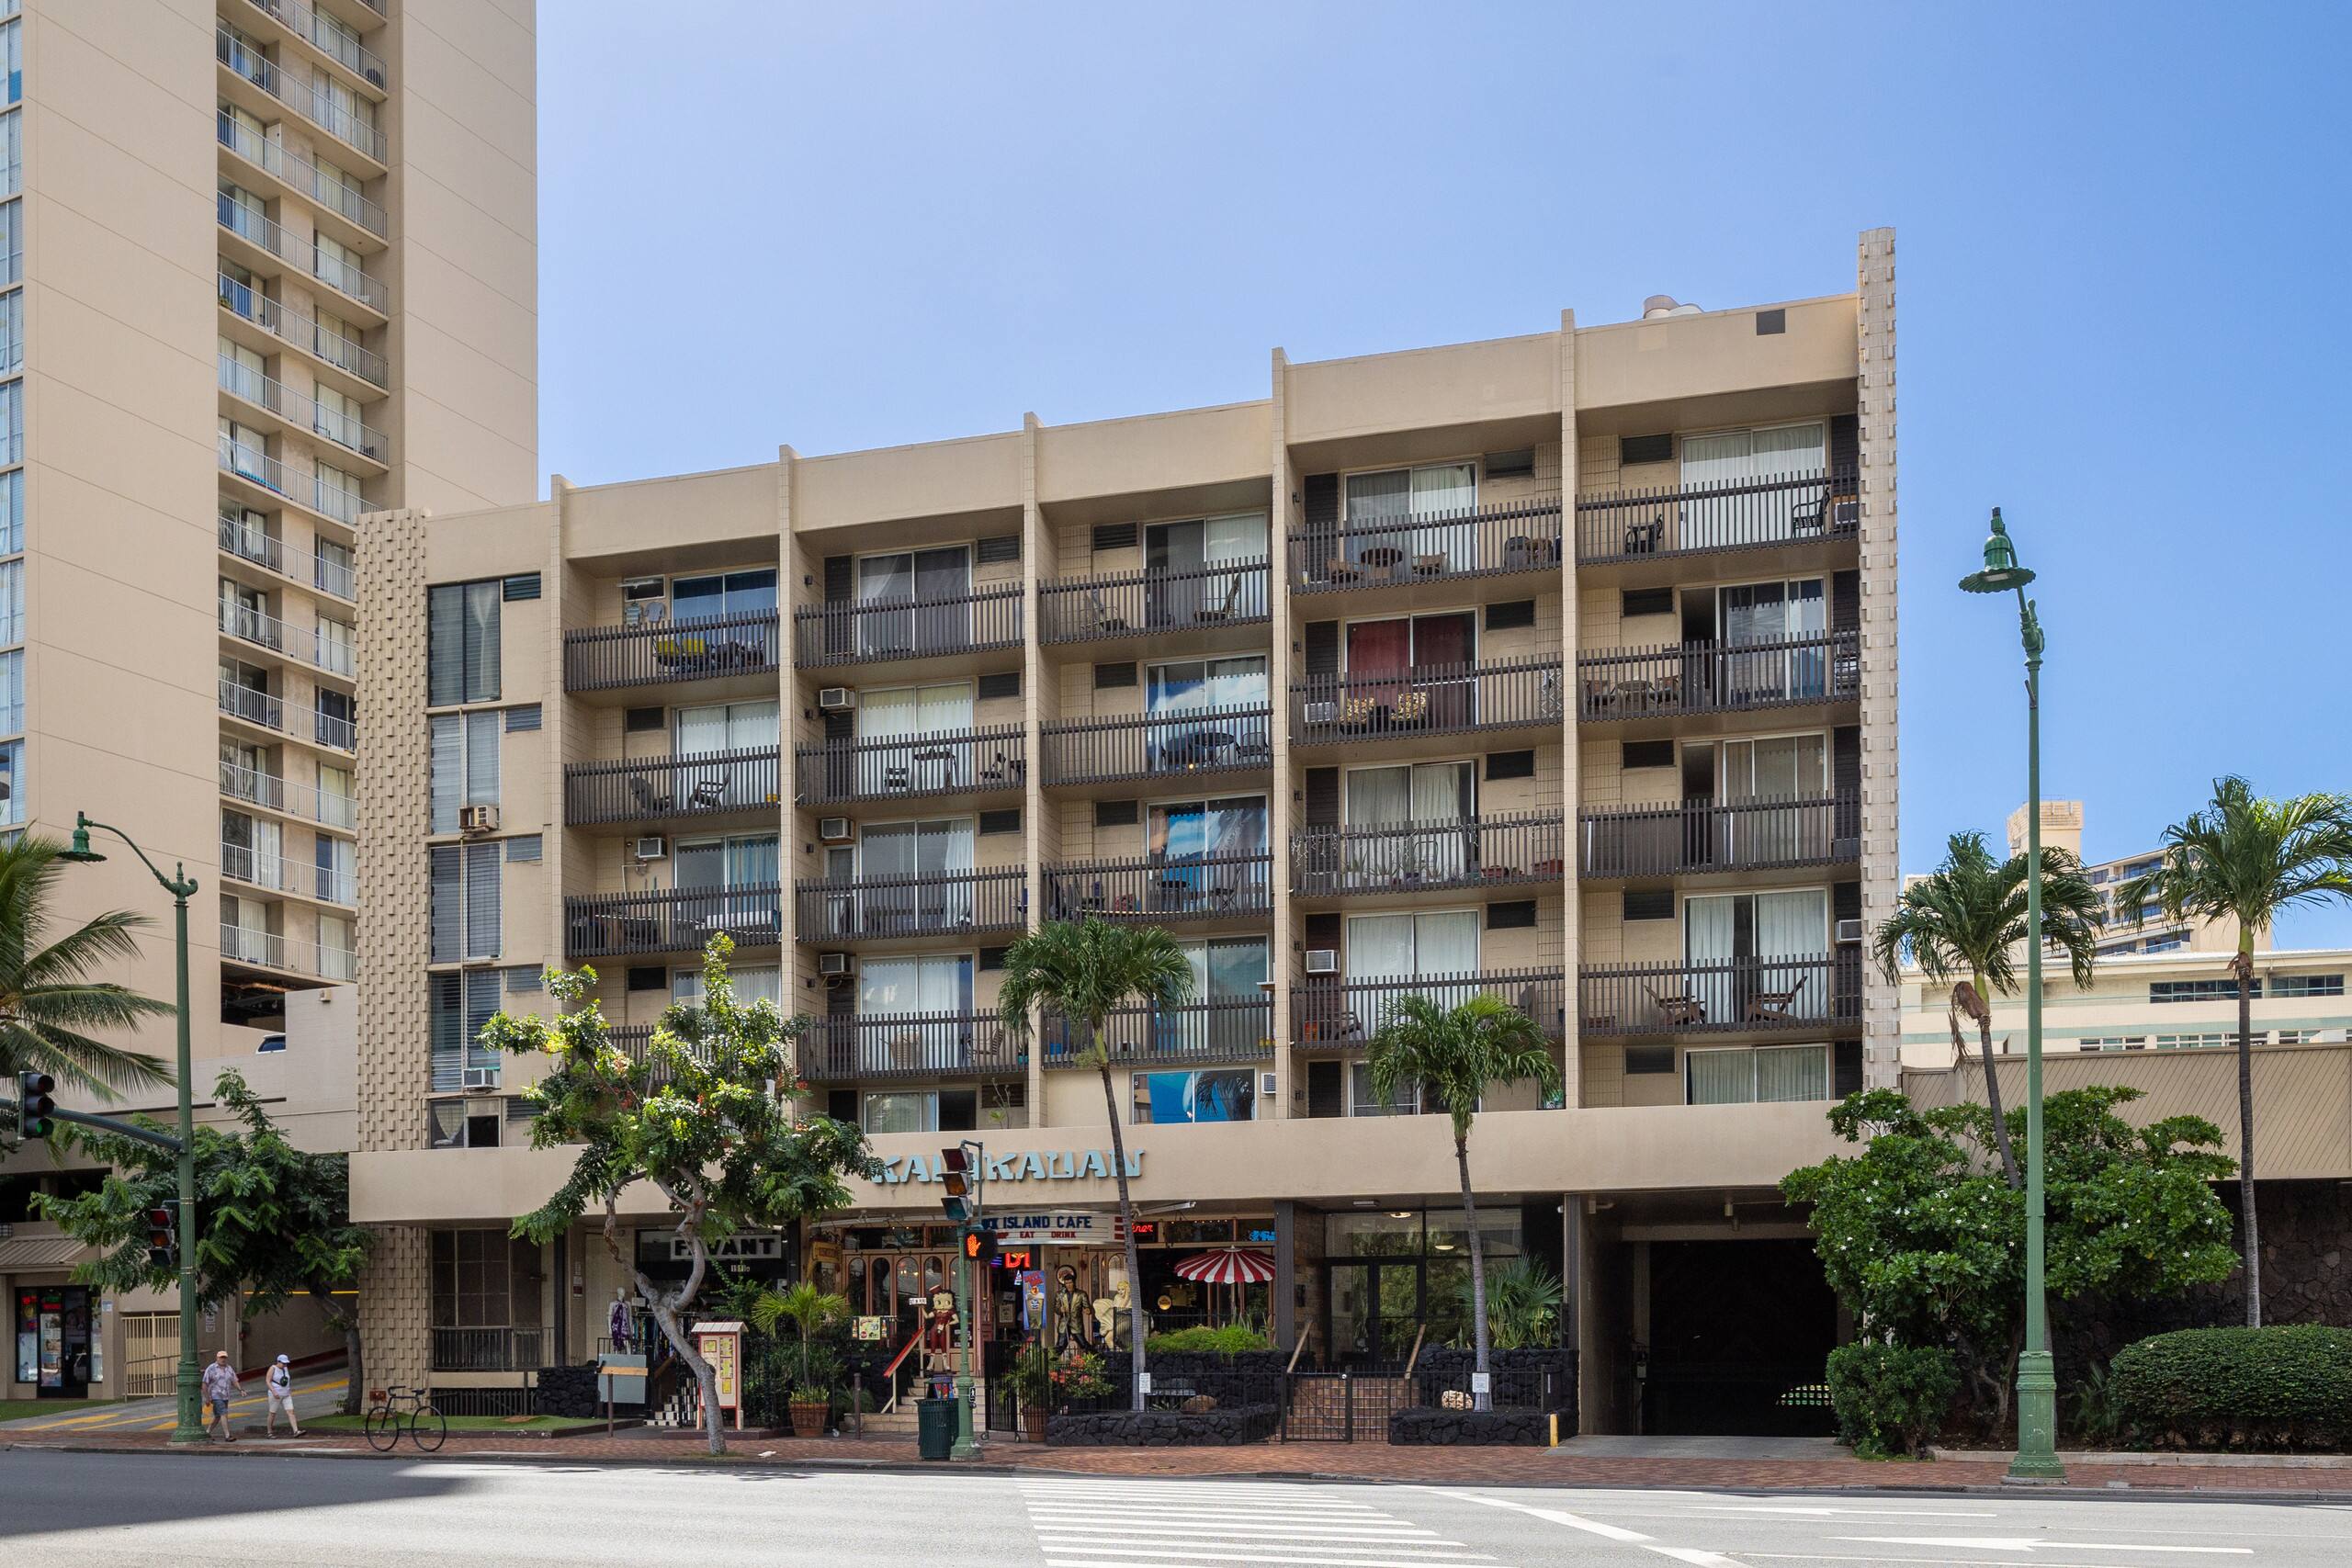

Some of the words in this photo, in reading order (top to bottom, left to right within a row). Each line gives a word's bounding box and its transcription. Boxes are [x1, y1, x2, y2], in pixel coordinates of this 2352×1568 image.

[1003, 1215, 1050, 1229] ISLAND
[1057, 1215, 1092, 1229] CAFE
[1019, 1231, 1035, 1239] EAT
[1051, 1231, 1077, 1239] DRINK
